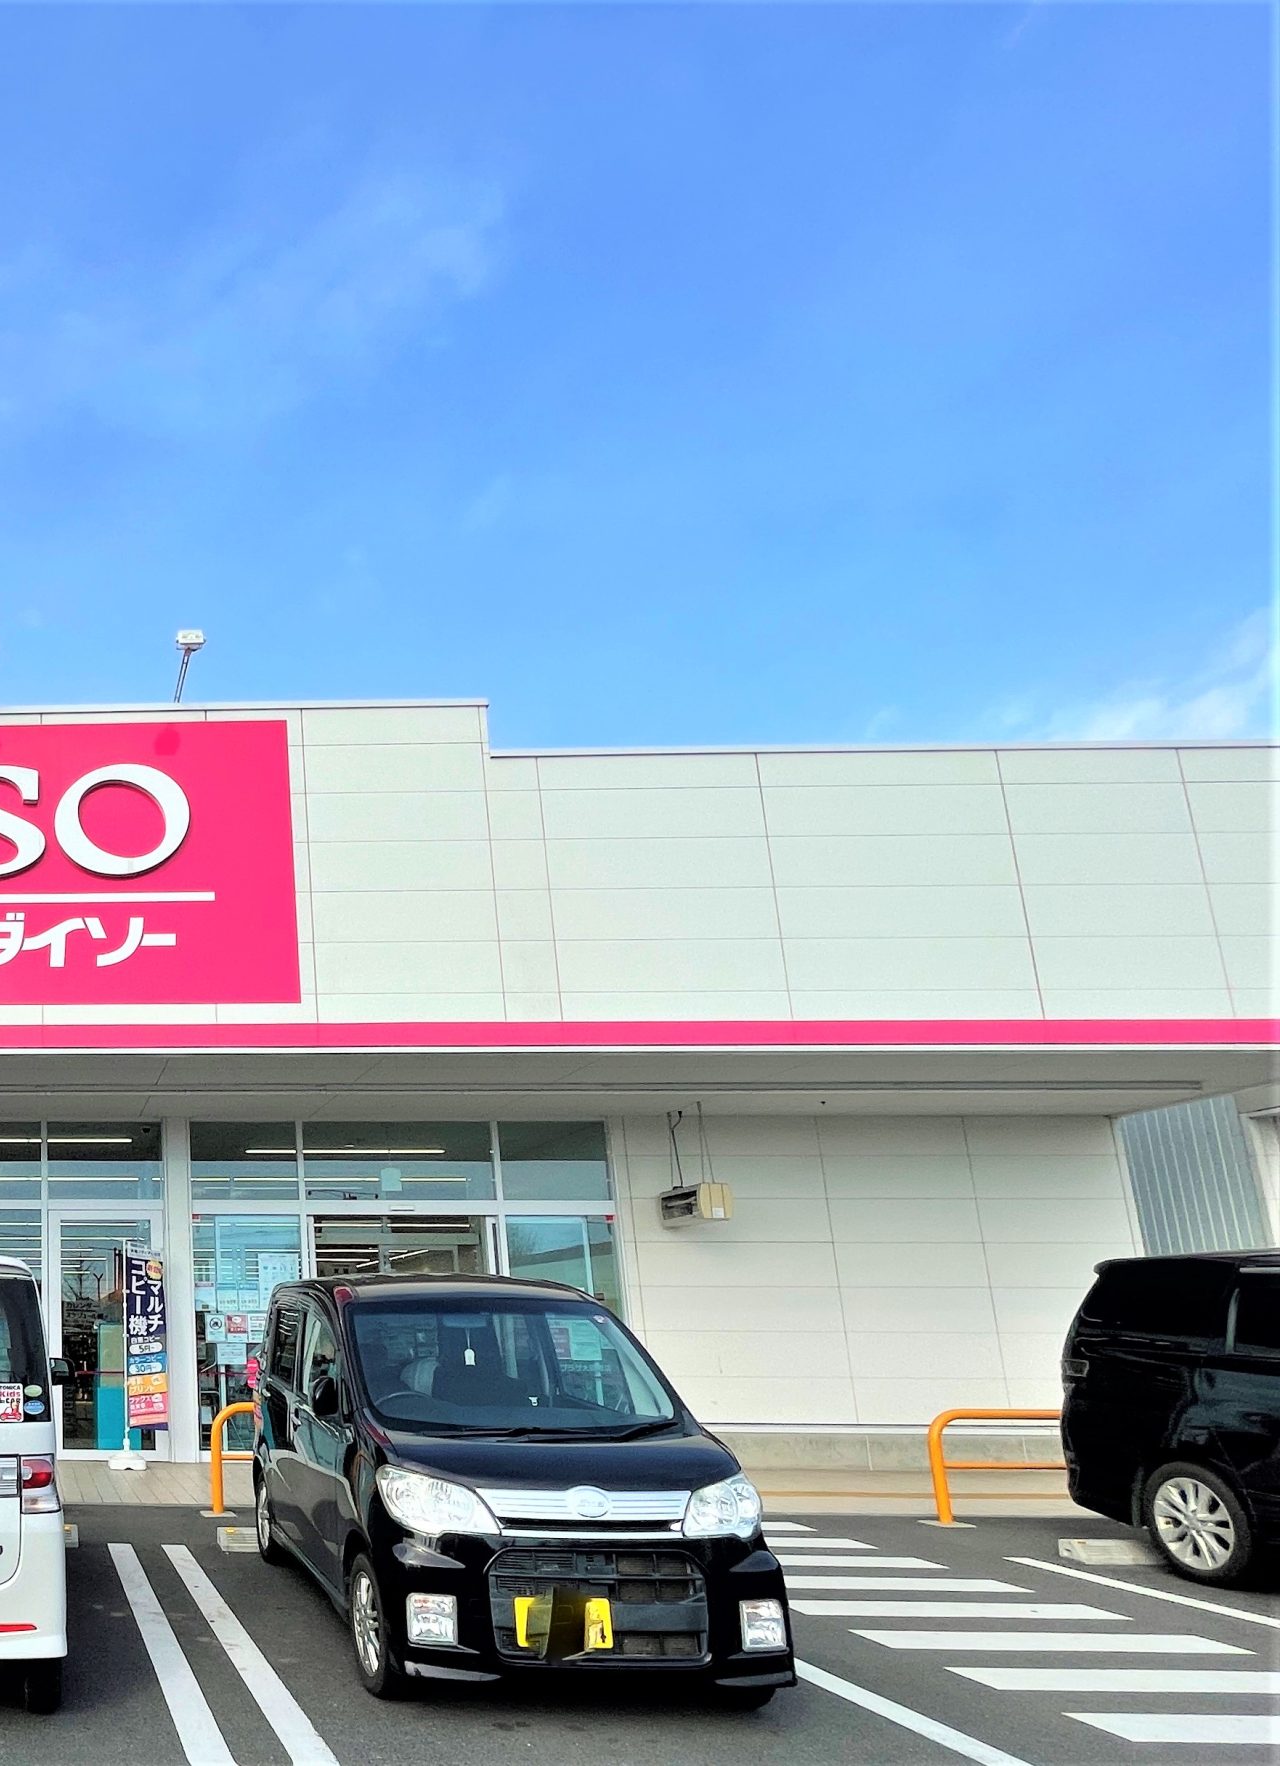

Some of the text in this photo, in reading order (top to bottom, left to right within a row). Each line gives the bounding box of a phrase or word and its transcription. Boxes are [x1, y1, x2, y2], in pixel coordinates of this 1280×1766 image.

[128, 1259, 148, 1336] コピー機
[146, 1279, 164, 1333] マルチ
